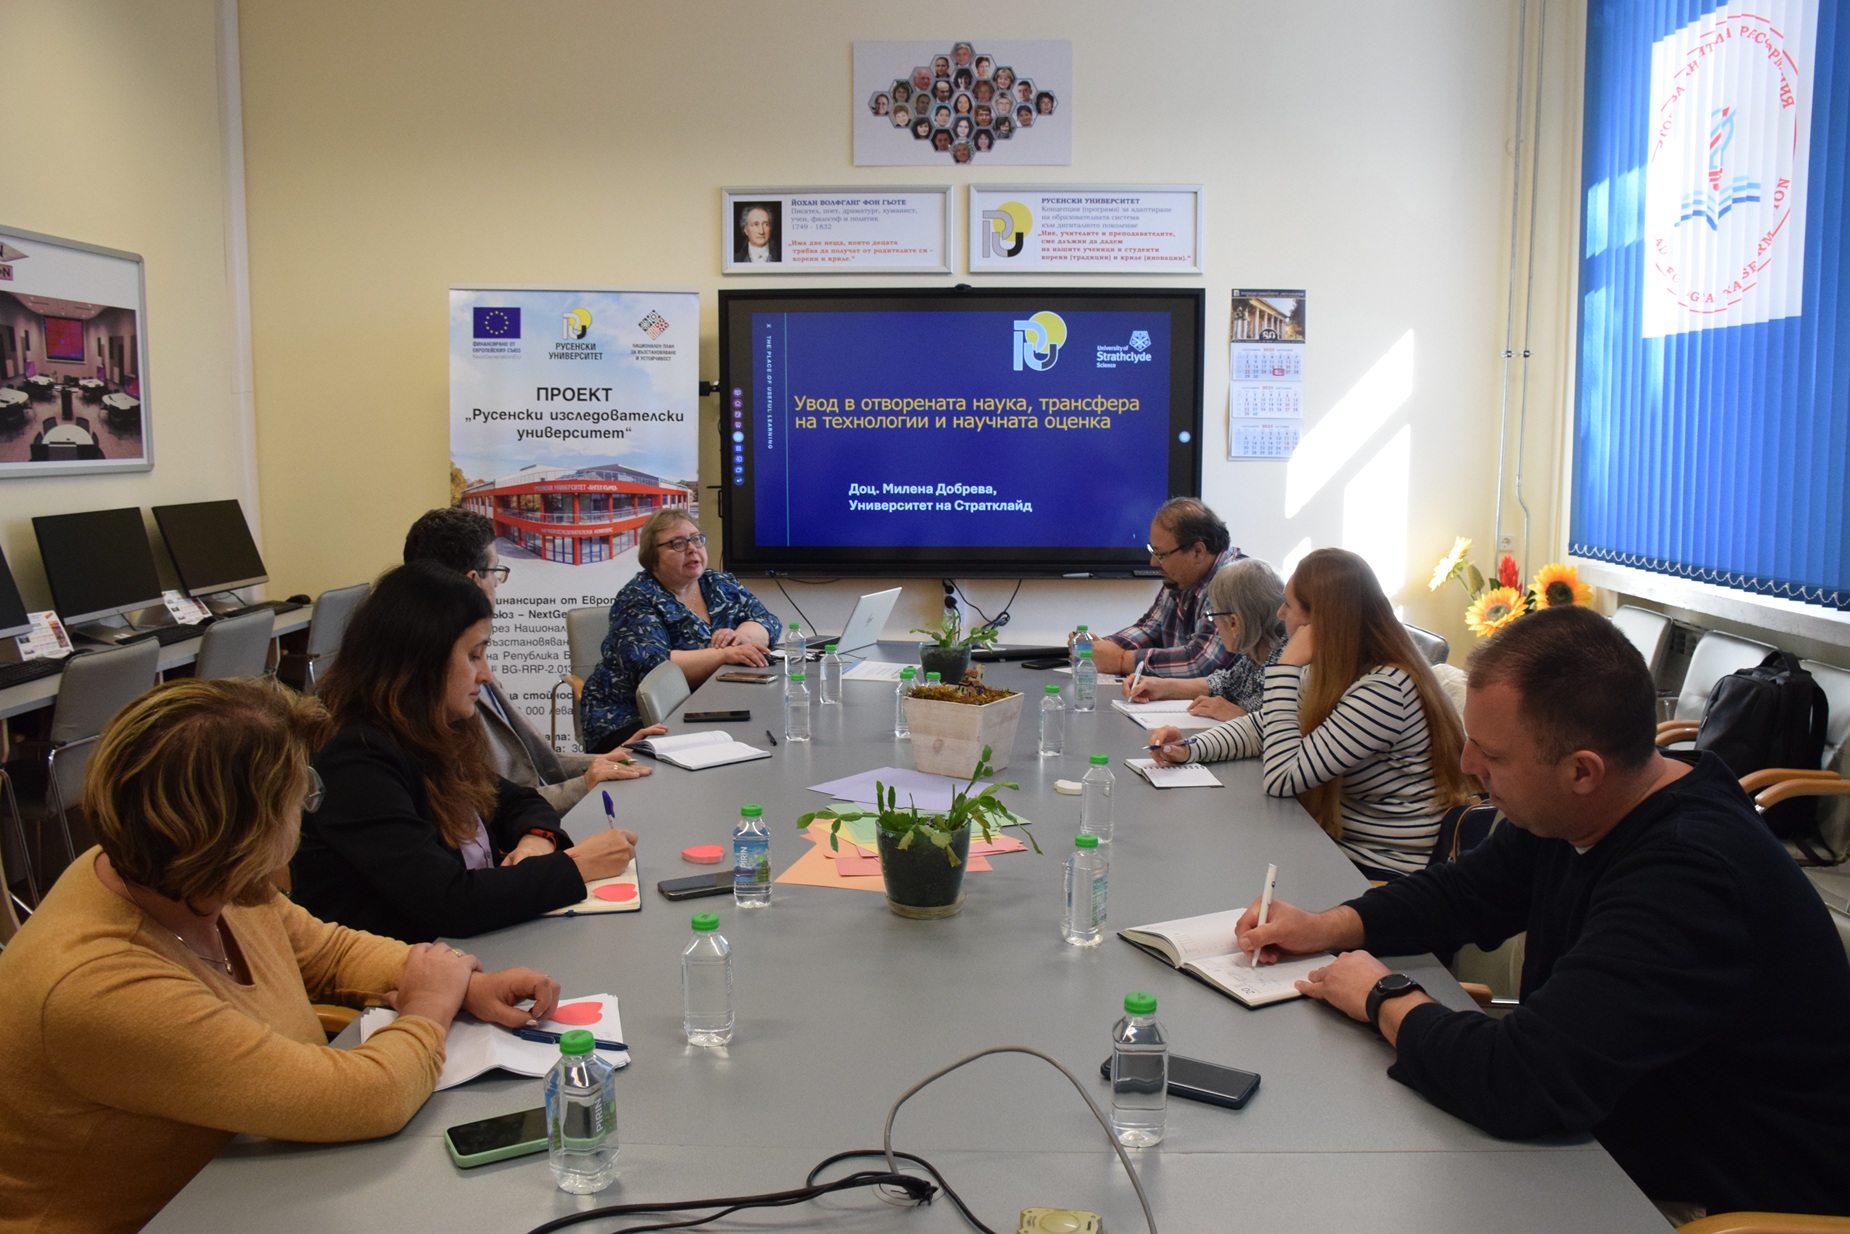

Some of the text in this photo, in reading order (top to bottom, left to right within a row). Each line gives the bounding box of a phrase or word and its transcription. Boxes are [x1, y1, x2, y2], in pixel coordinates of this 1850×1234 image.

[555, 343, 597, 351] РУСЕНСКИ
[548, 352, 604, 361] УНИВЕРСИТЕТ
[1096, 351, 1152, 364] Strathclyde
[767, 375, 773, 385] OF
[536, 387, 613, 402] ПРОЕКТ
[794, 395, 1140, 415] Увод в отворената наука, трансфера
[465, 408, 684, 424] „Русенски изследователски
[795, 416, 1112, 432] на технологии и научната оценка
[517, 427, 632, 441] университет“
[849, 483, 997, 496] Доц. Милена Добрева,
[849, 499, 1033, 513] Университет на Стратклайд
[496, 597, 556, 607] инансиран
[582, 596, 617, 607] Европ
[493, 610, 514, 619] ъюз
[529, 610, 567, 619] NextGe
[492, 624, 567, 635] рез Национал
[503, 651, 559, 662] Република
[595, 1098, 603, 1133] PIRIN
